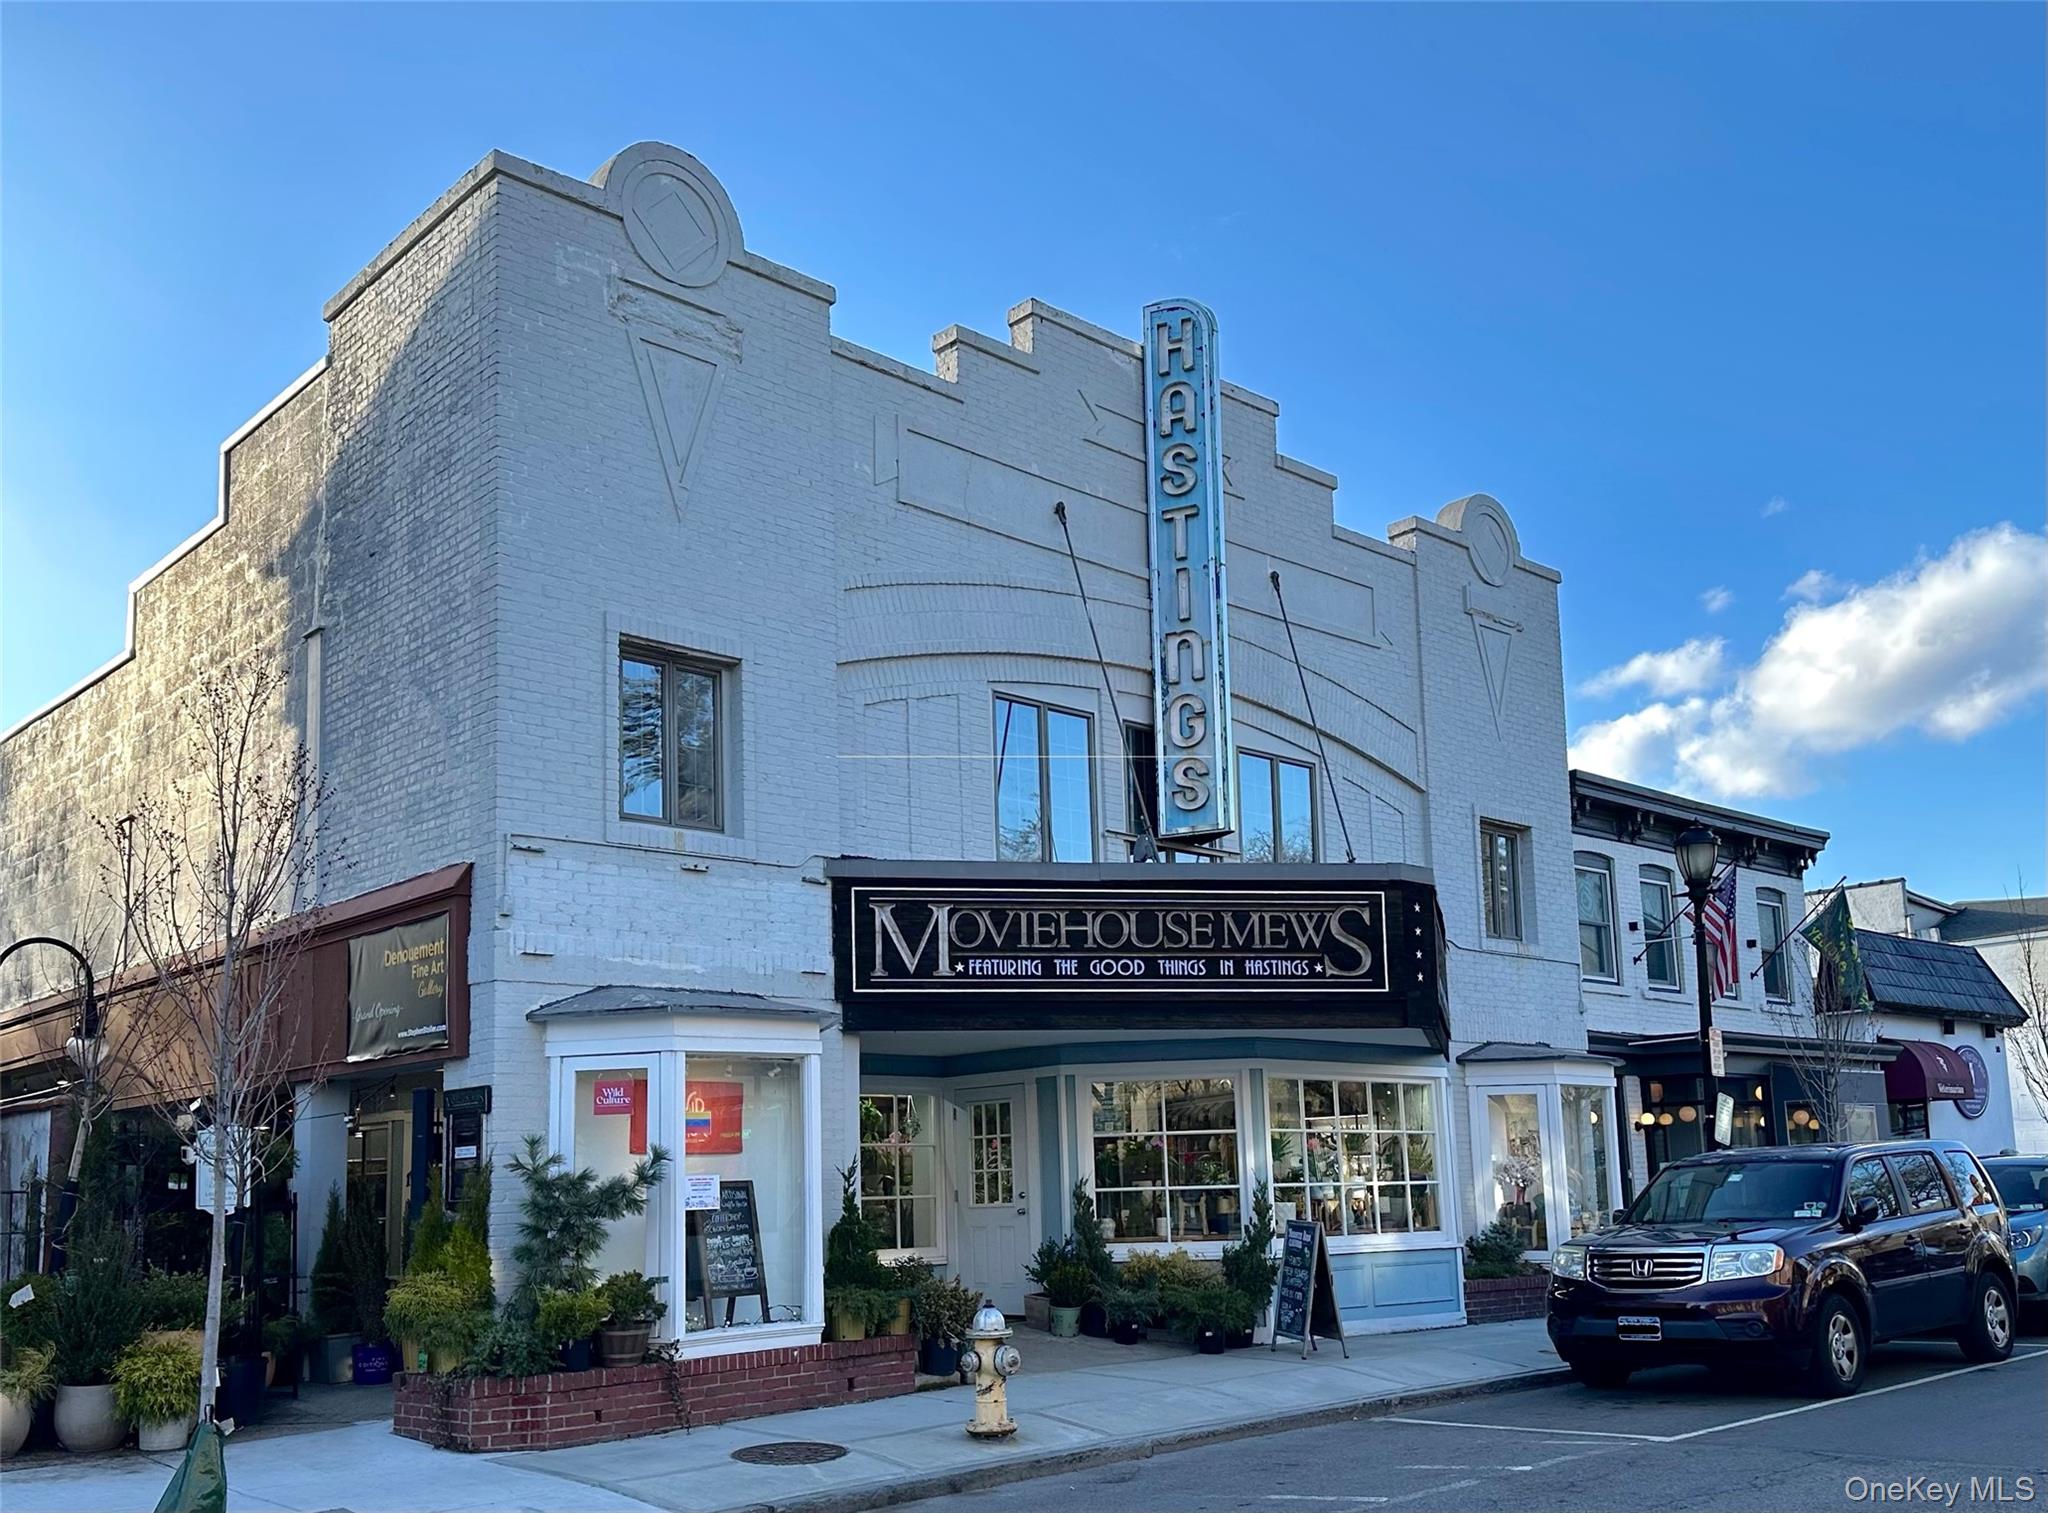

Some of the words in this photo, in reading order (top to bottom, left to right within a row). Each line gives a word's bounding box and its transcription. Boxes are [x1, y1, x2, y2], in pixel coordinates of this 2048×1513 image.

[1156, 317, 1210, 811] HASTINGS
[384, 937, 445, 967] Denouement
[411, 964, 429, 979] Fine
[431, 960, 445, 977] Art
[968, 958, 1042, 976] FEATURING
[1053, 958, 1079, 976] THE
[1090, 958, 1146, 976] GOOD
[1157, 958, 1207, 976] THINGS
[1220, 958, 1234, 976] IN
[1244, 958, 1310, 976] HASTINGS
[596, 1095, 631, 1105] Culture
[602, 1087, 624, 1097] Wild
